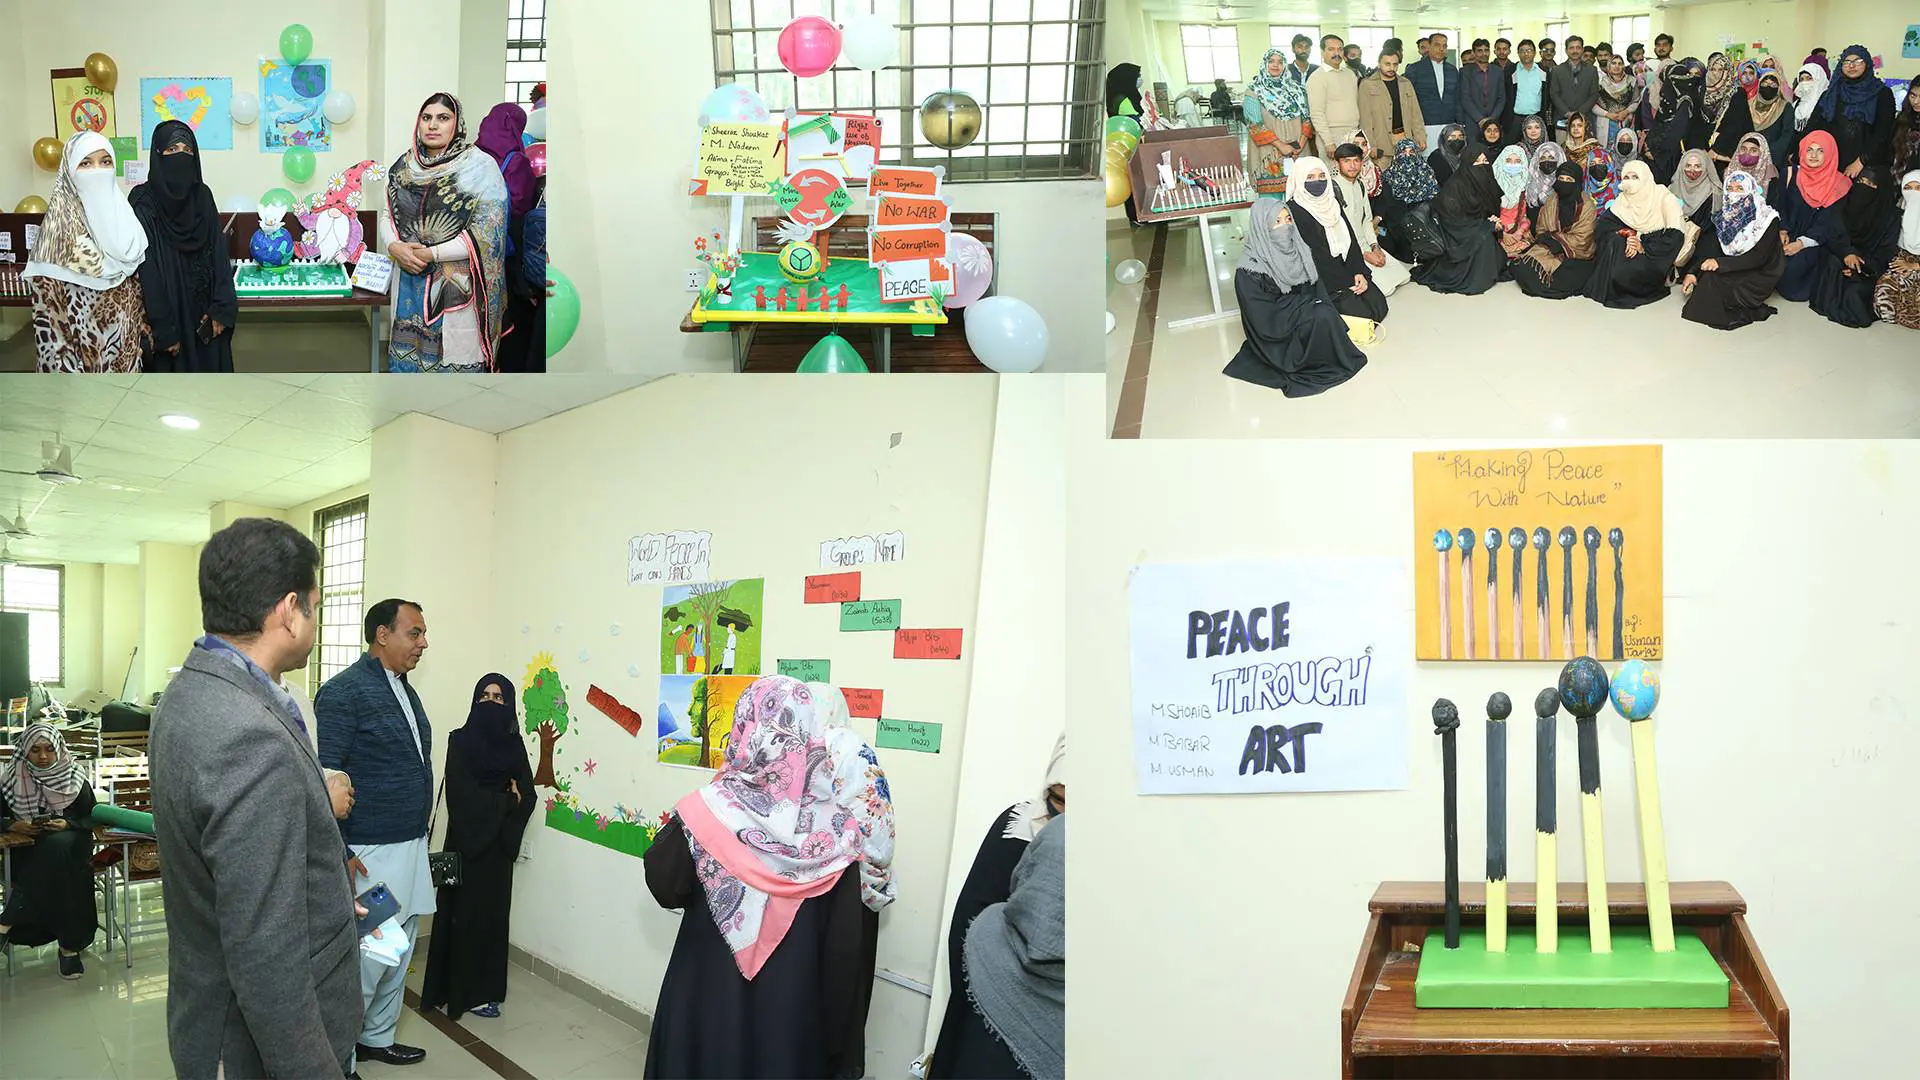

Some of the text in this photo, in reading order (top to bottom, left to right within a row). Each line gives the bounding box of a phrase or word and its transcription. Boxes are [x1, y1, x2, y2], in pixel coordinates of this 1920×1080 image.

[873, 177, 924, 192] Live Together
[779, 196, 800, 205] Peace
[833, 190, 847, 200] No
[829, 200, 846, 209] War
[884, 203, 938, 220] No WAR
[872, 236, 940, 253] No Corruption
[1543, 448, 1605, 482] Peace
[1469, 487, 1519, 509] With
[1186, 600, 1291, 660] PEACE
[1624, 634, 1662, 647] Usman
[1211, 655, 1372, 716] THROUGH
[1238, 721, 1324, 776] ART
